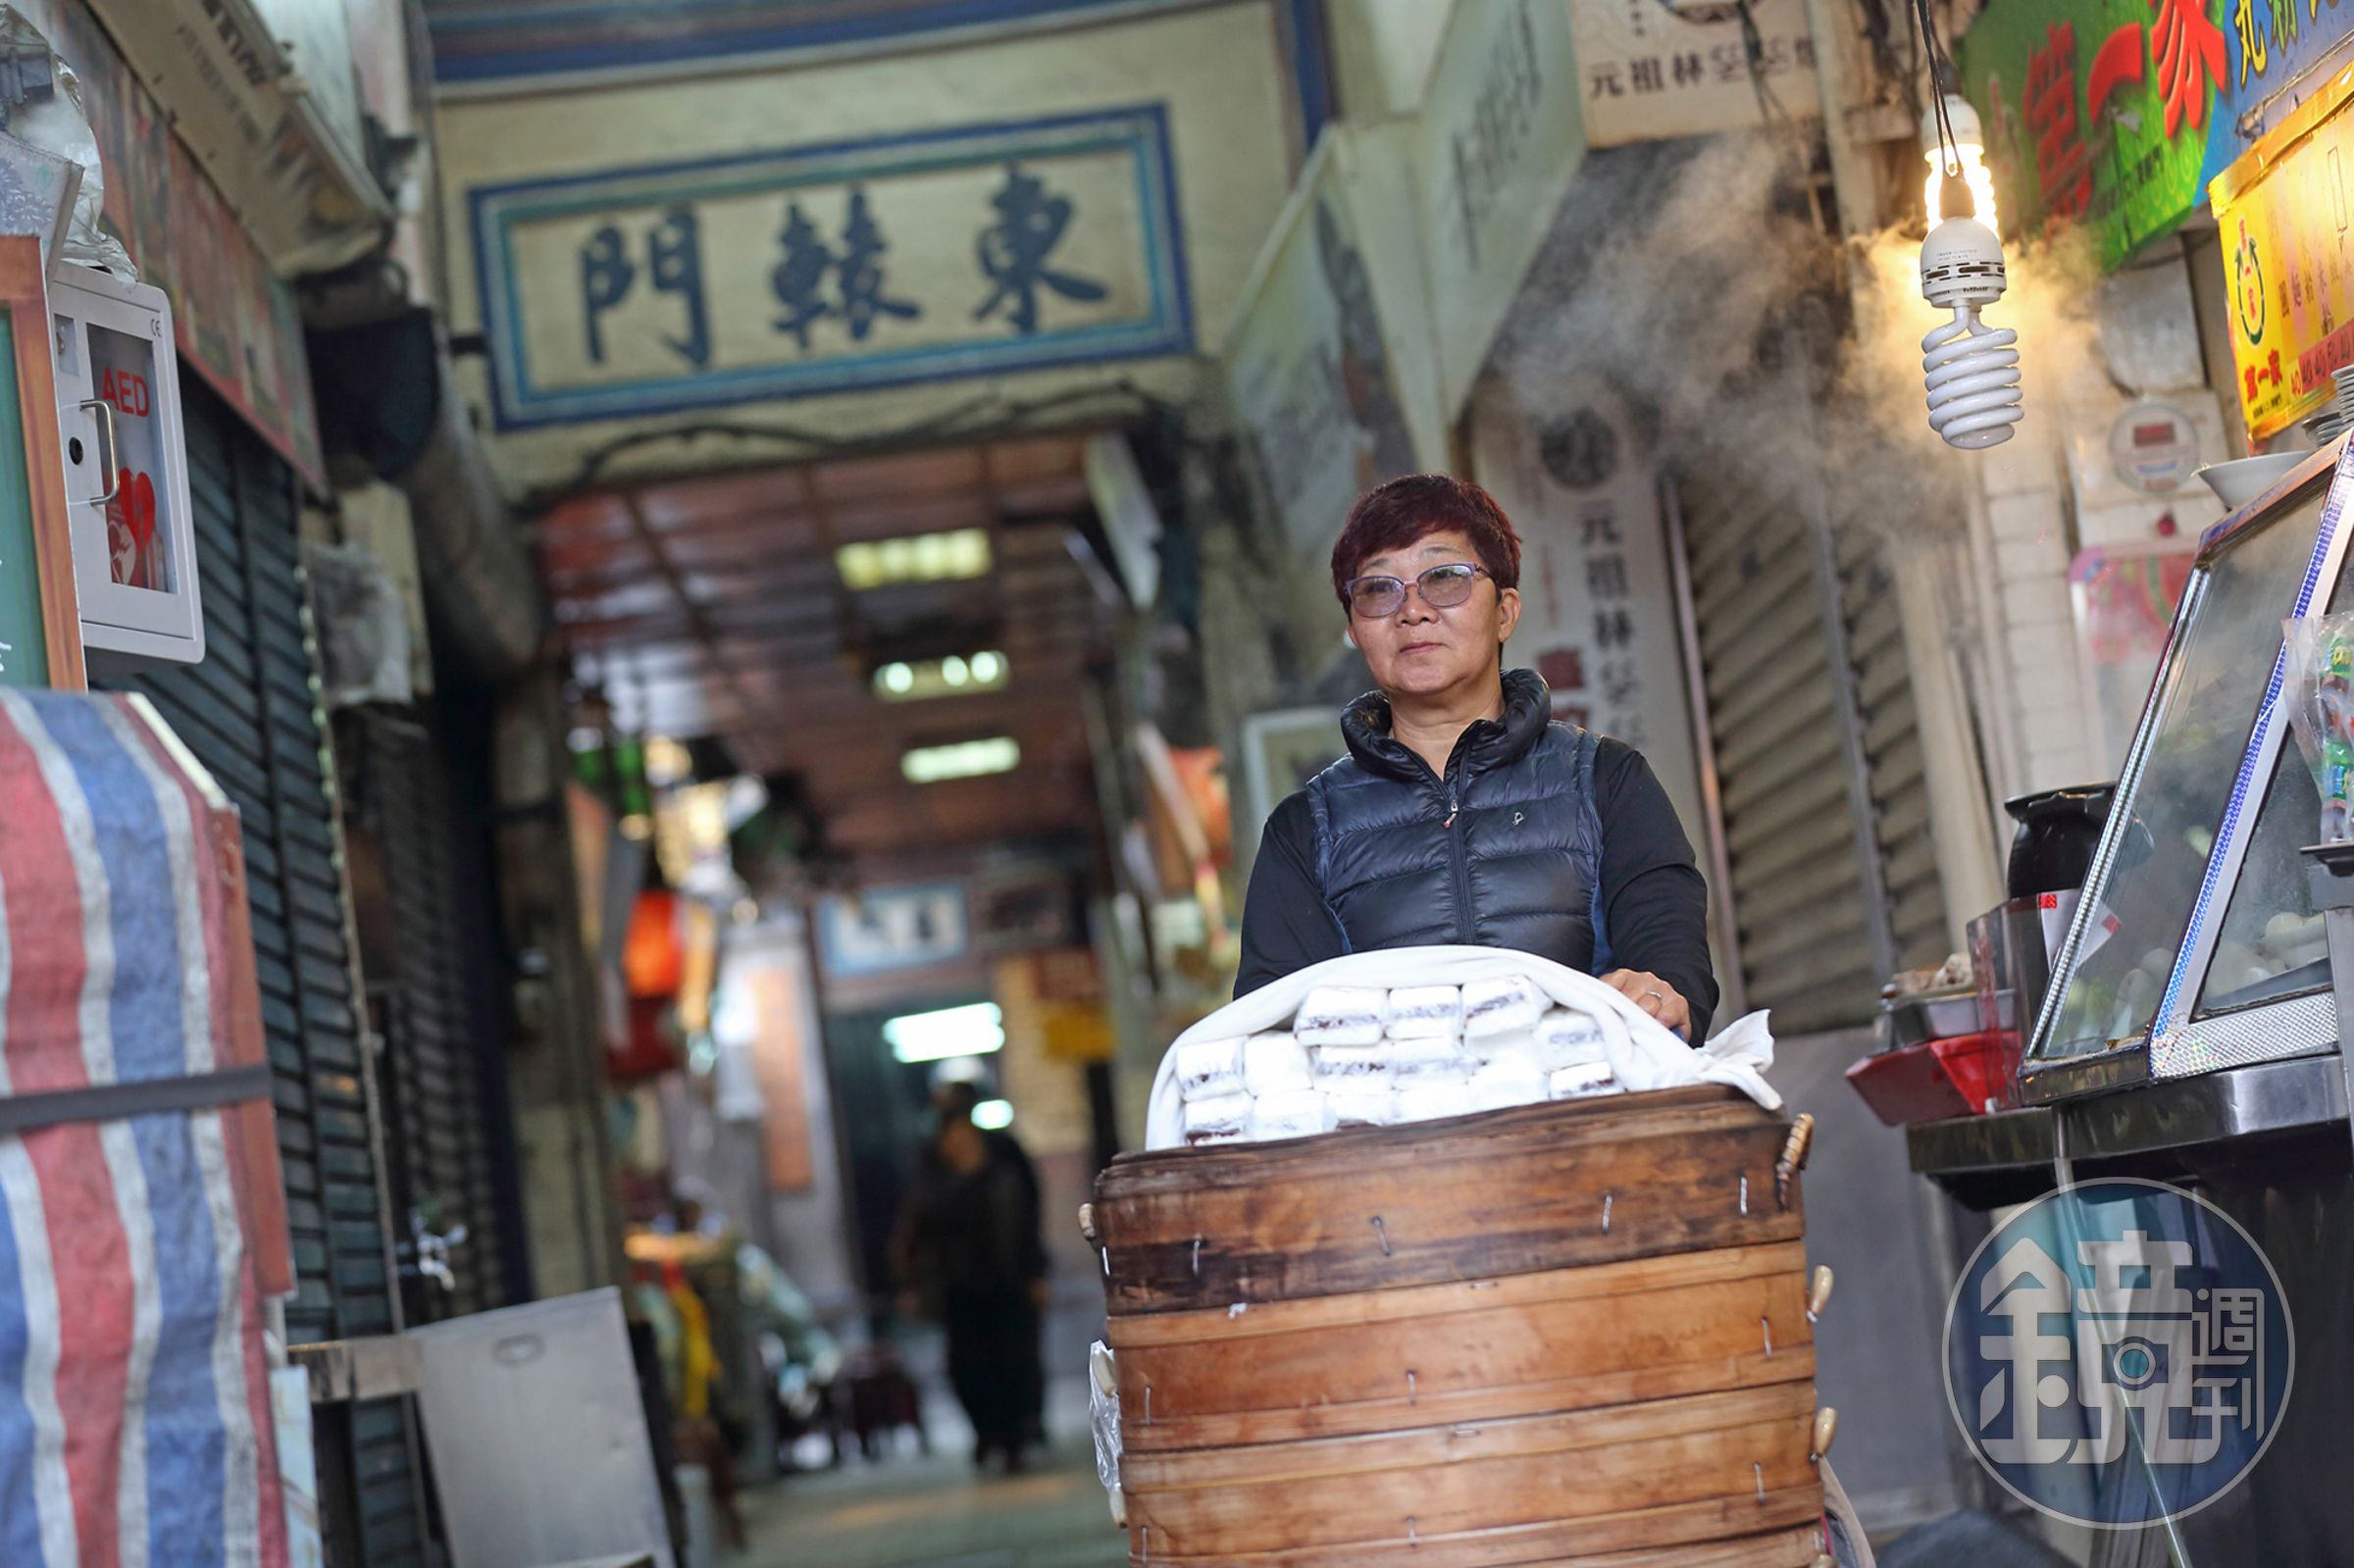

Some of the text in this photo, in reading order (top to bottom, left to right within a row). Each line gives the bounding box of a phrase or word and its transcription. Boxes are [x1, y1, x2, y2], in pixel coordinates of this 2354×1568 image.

[579, 162, 1110, 371] 東轅門
[102, 366, 149, 418] AED
